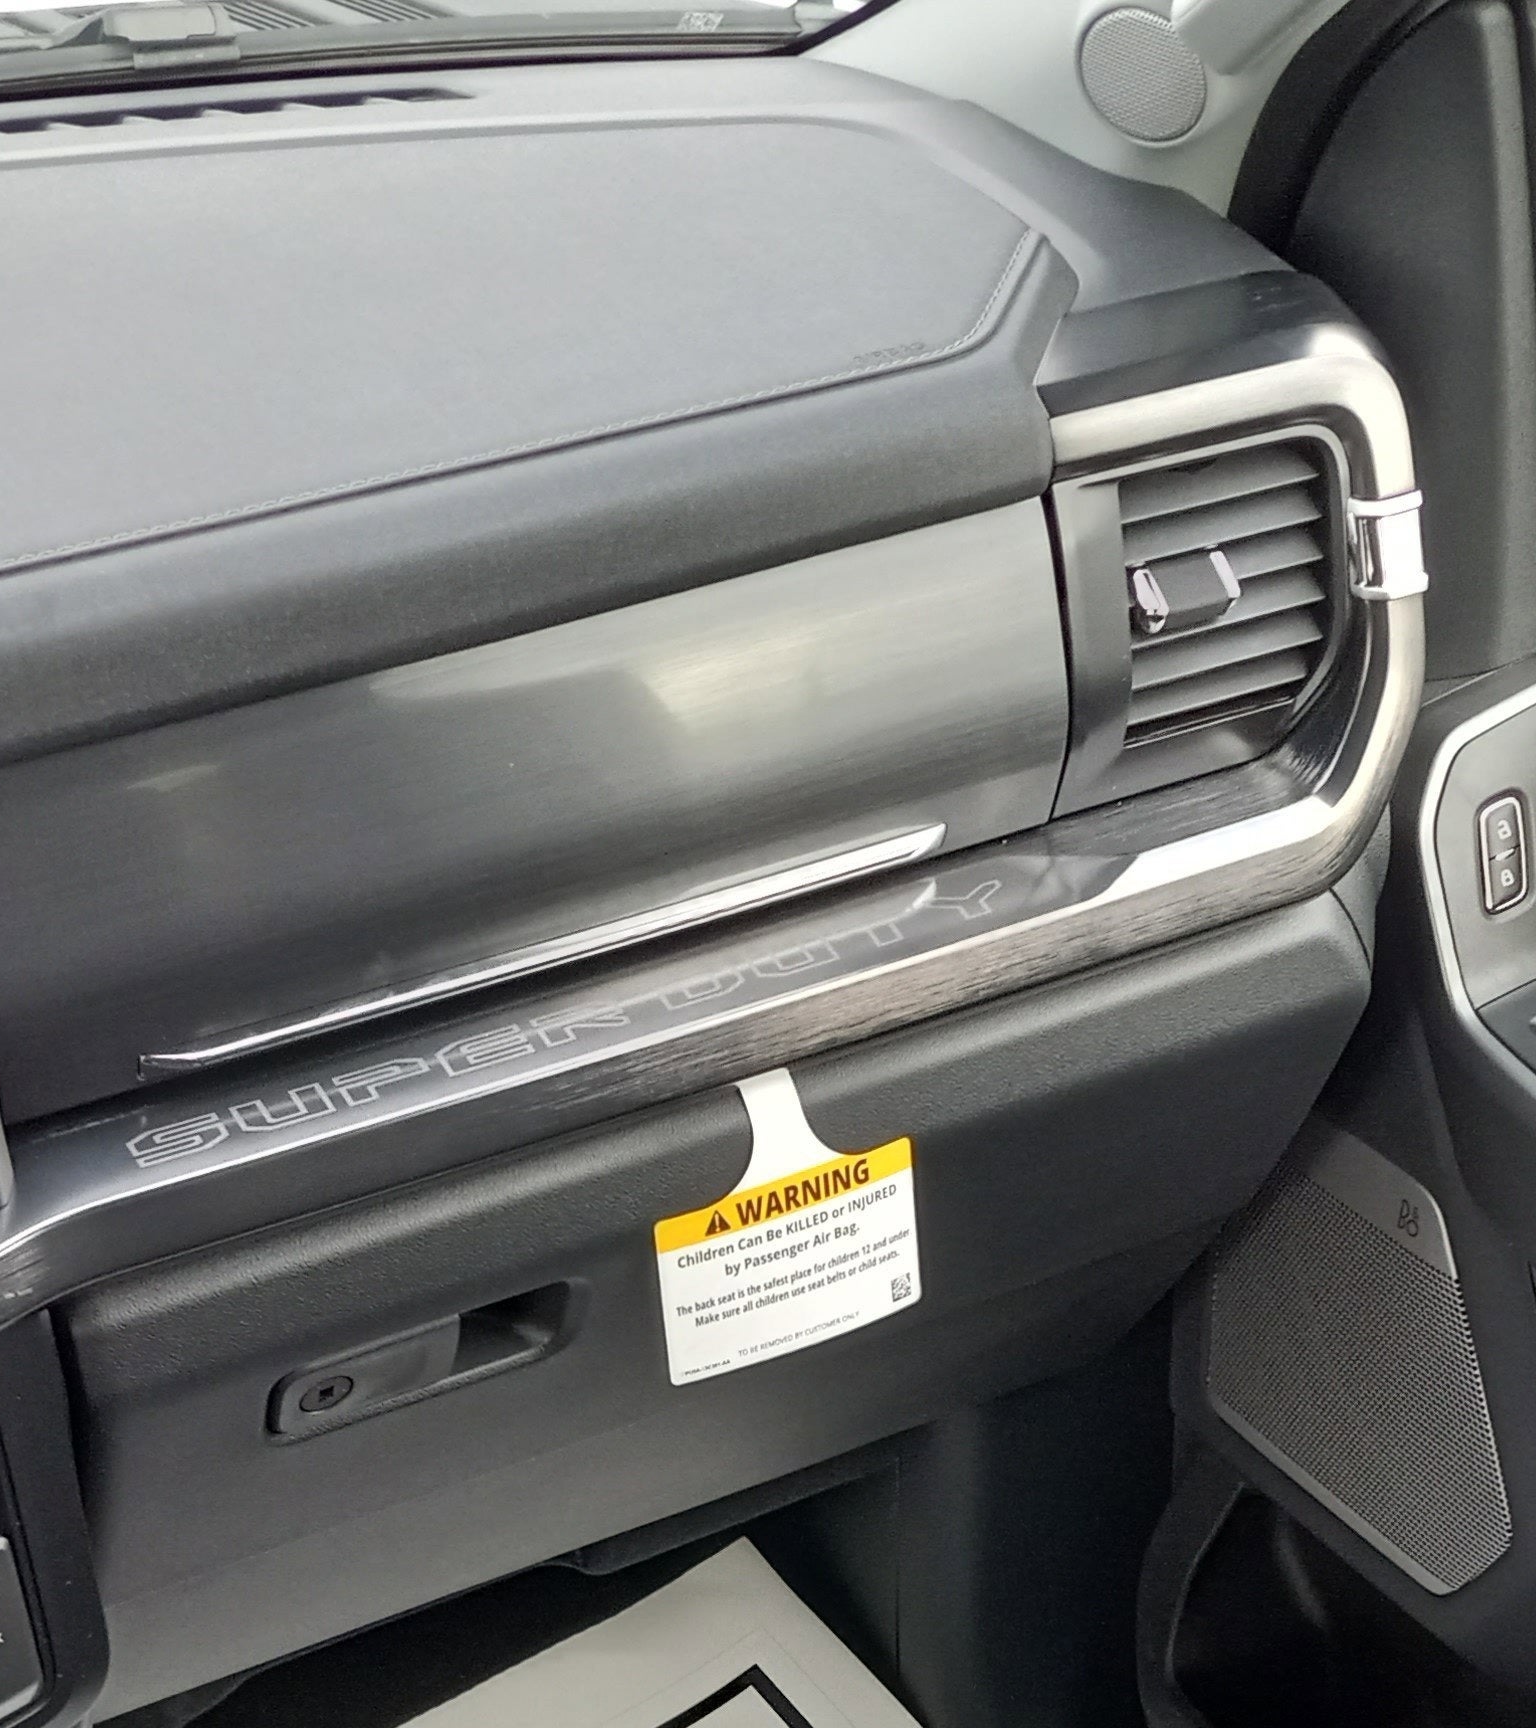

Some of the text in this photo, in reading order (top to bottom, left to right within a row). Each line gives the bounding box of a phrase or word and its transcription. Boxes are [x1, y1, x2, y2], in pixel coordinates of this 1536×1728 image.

[126, 1004, 630, 1168] SUPER
[677, 1184, 897, 1268] Children Can Be KILLED or INJURED
[735, 1159, 870, 1226] WARNING
[676, 1229, 910, 1316] The back seat is the safest place for children 12 and under
[695, 1250, 900, 1327] Make sure all children use seat belts or child seats.
[725, 1223, 860, 1277] by Passenger Air Bag.
[738, 1349, 748, 1357] TO
[750, 1345, 758, 1353] BE
[760, 1334, 794, 1350] REMOVED
[794, 1330, 804, 1340] BY
[804, 1315, 841, 1336] CUSTOMER
